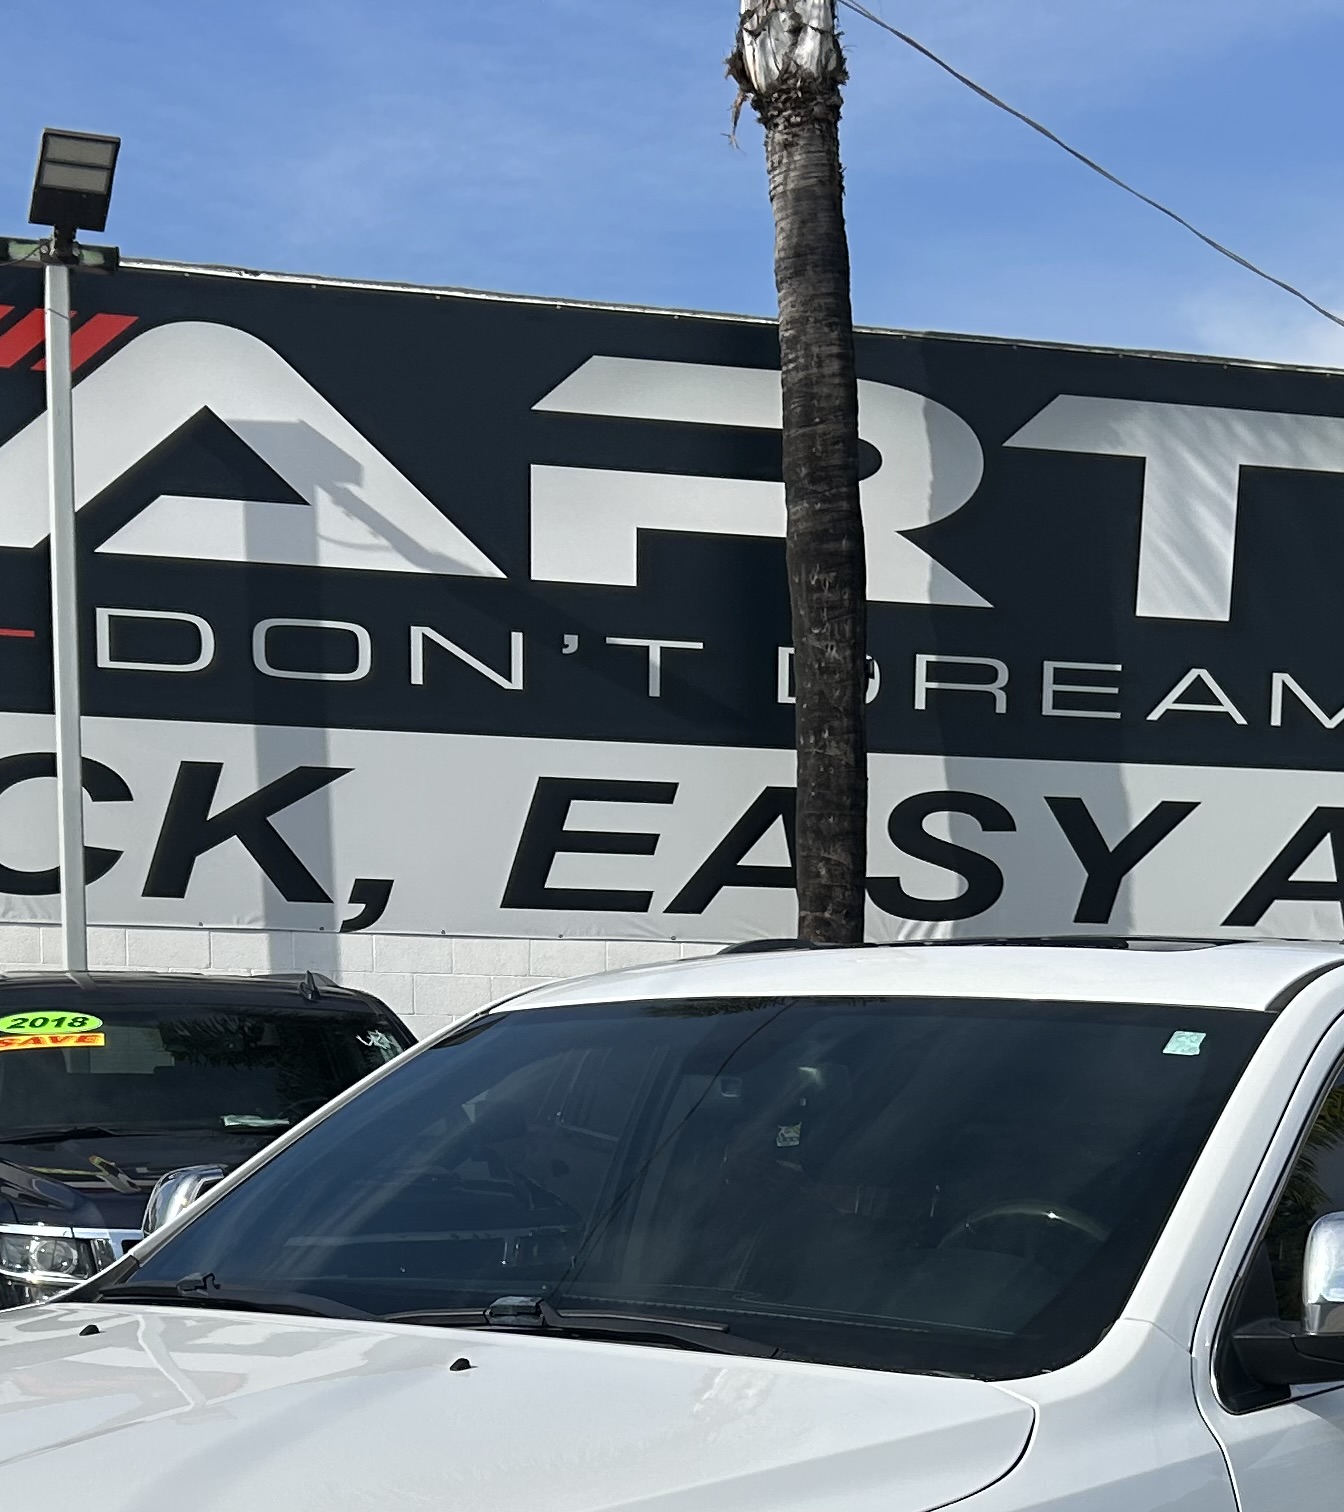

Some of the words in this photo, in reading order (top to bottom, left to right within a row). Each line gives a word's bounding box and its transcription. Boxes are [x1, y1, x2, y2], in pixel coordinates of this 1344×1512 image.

[96, 606, 704, 698] DON'T
[500, 776, 1202, 924] EASY
[6, 1016, 90, 1030] 2018
